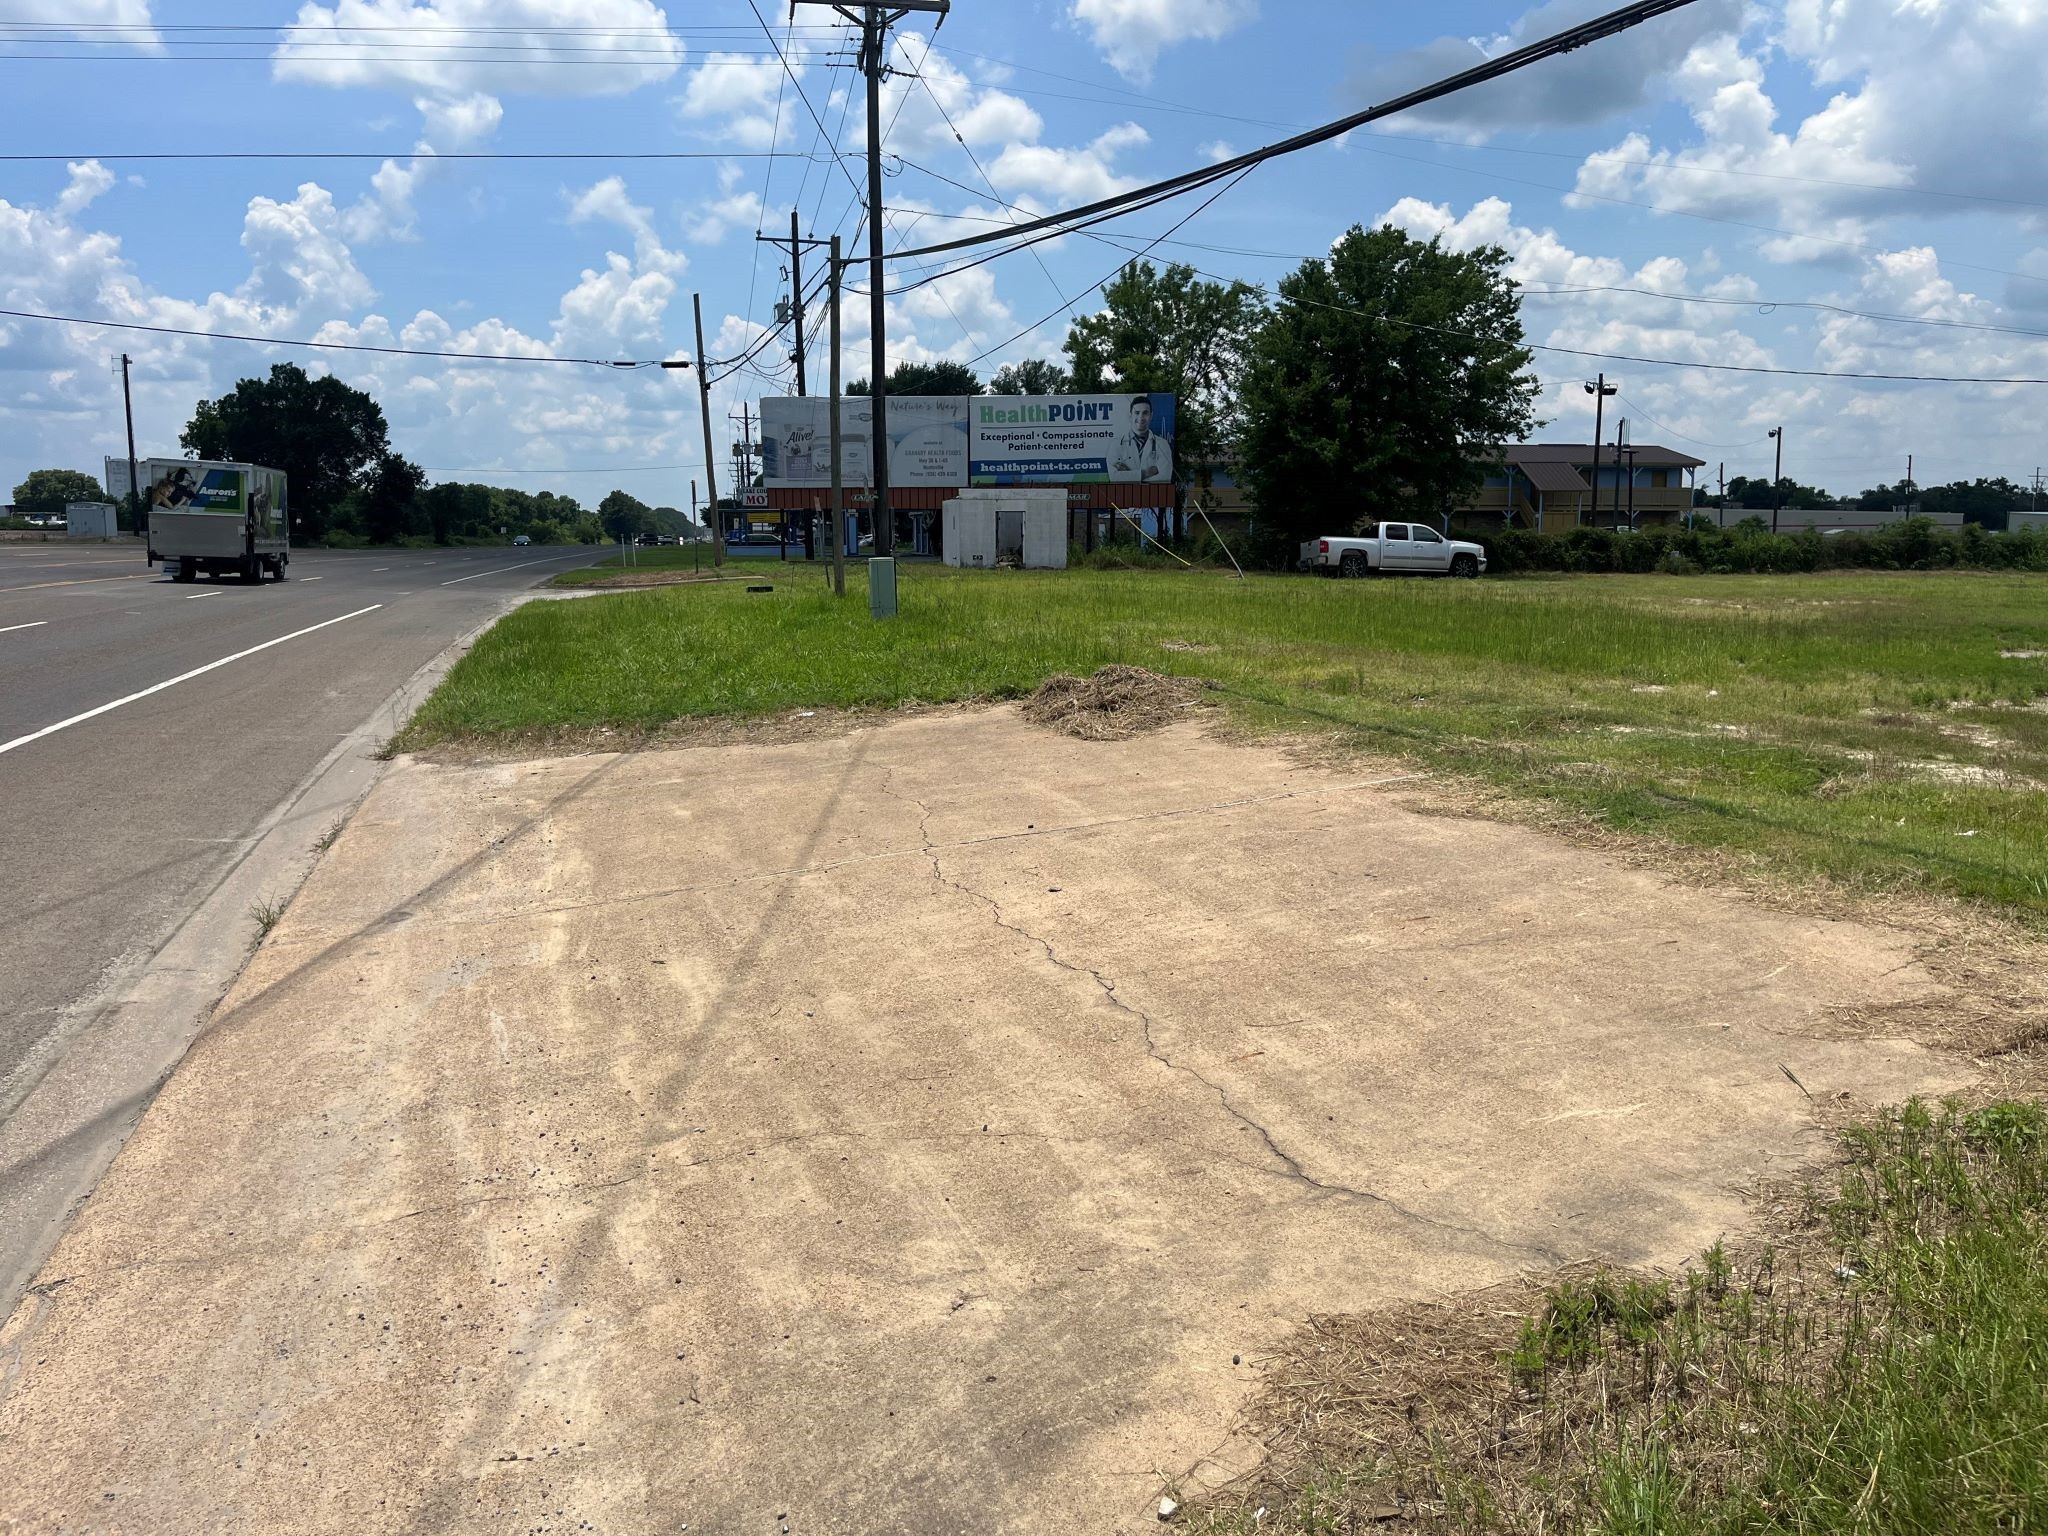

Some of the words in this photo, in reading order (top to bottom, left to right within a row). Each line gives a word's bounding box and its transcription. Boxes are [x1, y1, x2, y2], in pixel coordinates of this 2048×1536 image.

[890, 400, 932, 411] Nature's
[936, 400, 960, 417] Way
[786, 430, 815, 444] Alive!
[980, 431, 1035, 443] Exceptional
[1042, 430, 1114, 441] Compassionate
[1008, 441, 1084, 451] Patient-centered
[980, 461, 1101, 473] healthpoint-tx.com
[199, 486, 237, 497] Aaron's
